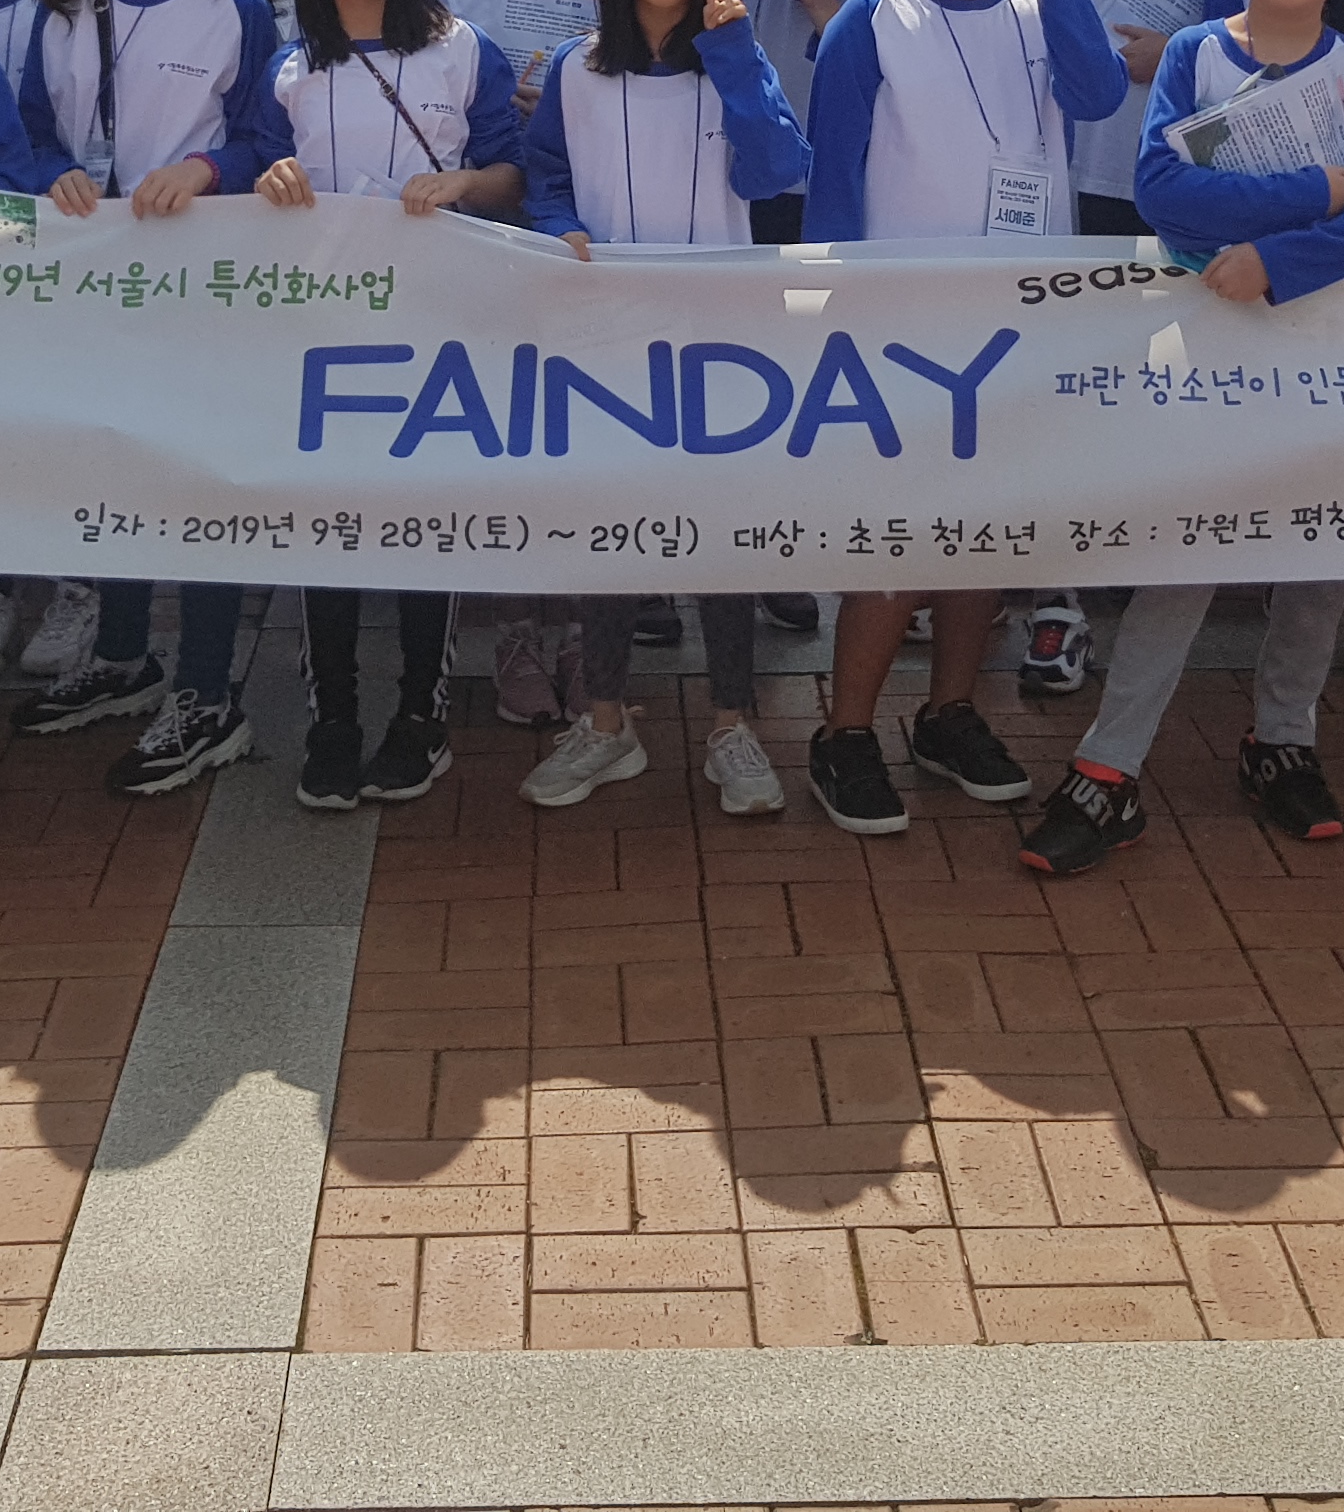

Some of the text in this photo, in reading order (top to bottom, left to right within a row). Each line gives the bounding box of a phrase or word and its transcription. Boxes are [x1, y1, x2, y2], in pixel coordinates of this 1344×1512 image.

[1001, 178, 1039, 192] FAINDAY
[76, 261, 187, 308] 서울시
[205, 259, 395, 311] 특성화사업
[297, 327, 1020, 460] FAINDAY
[1055, 365, 1125, 407] 파란
[1138, 361, 1280, 407] 청소년이
[74, 505, 145, 543] 일자
[182, 515, 294, 549] 2019년
[312, 511, 363, 551] 9월
[379, 513, 530, 554] 28일(토)
[589, 514, 699, 558] 29(일)
[734, 520, 805, 558] 대상
[845, 517, 914, 559] 초등
[932, 515, 1037, 558] 청소년
[1068, 517, 1131, 553] 장소
[1176, 514, 1274, 547] 강원도
[1061, 774, 1115, 827] JUST
